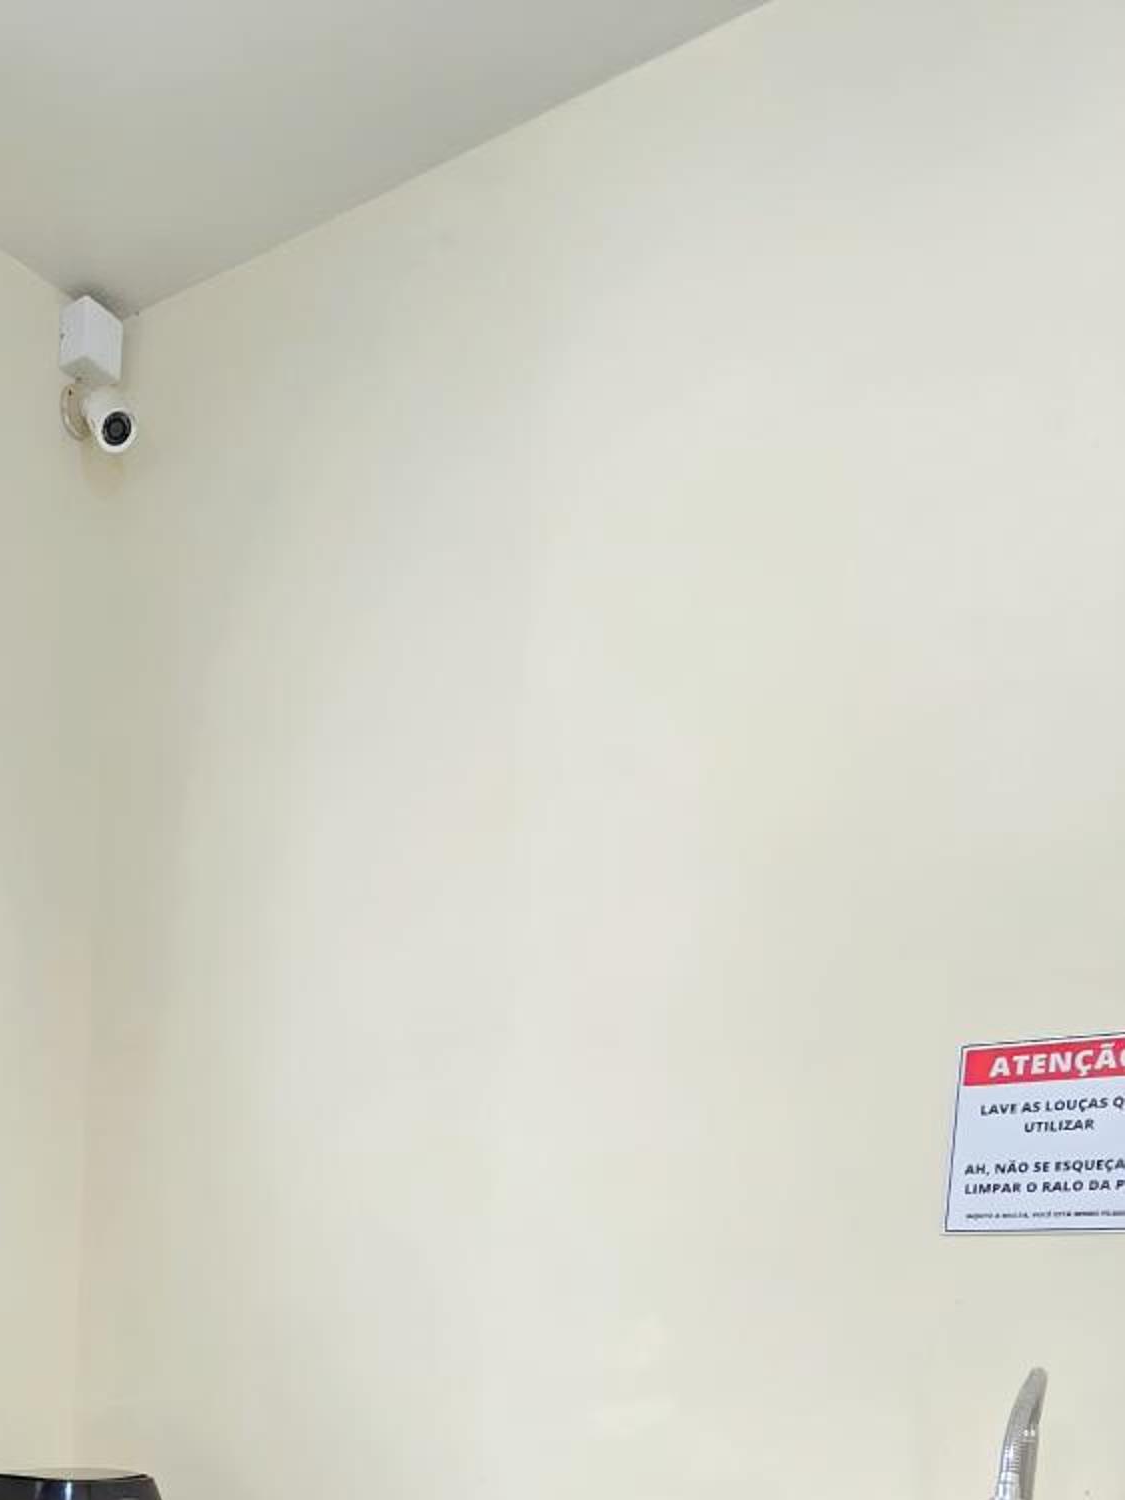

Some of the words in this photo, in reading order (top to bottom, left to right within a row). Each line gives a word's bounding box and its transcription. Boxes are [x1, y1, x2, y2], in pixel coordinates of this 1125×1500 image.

[989, 1043, 1125, 1078] ATENÇÃ
[981, 1103, 1017, 1115] LAVE
[1022, 1101, 1041, 1112] AS
[1045, 1097, 1108, 1113] LOUÇAS
[1024, 1119, 1095, 1132] UTILIZAR
[964, 1164, 990, 1176] AH,
[994, 1160, 1030, 1174] NÃO
[1033, 1161, 1050, 1173] SE
[1055, 1158, 1125, 1173] ESQUEÇA
[964, 1183, 1021, 1195] LIMPAR
[1026, 1181, 1038, 1192] O
[1042, 1180, 1084, 1193] RALO
[1089, 1180, 1111, 1191] DA
